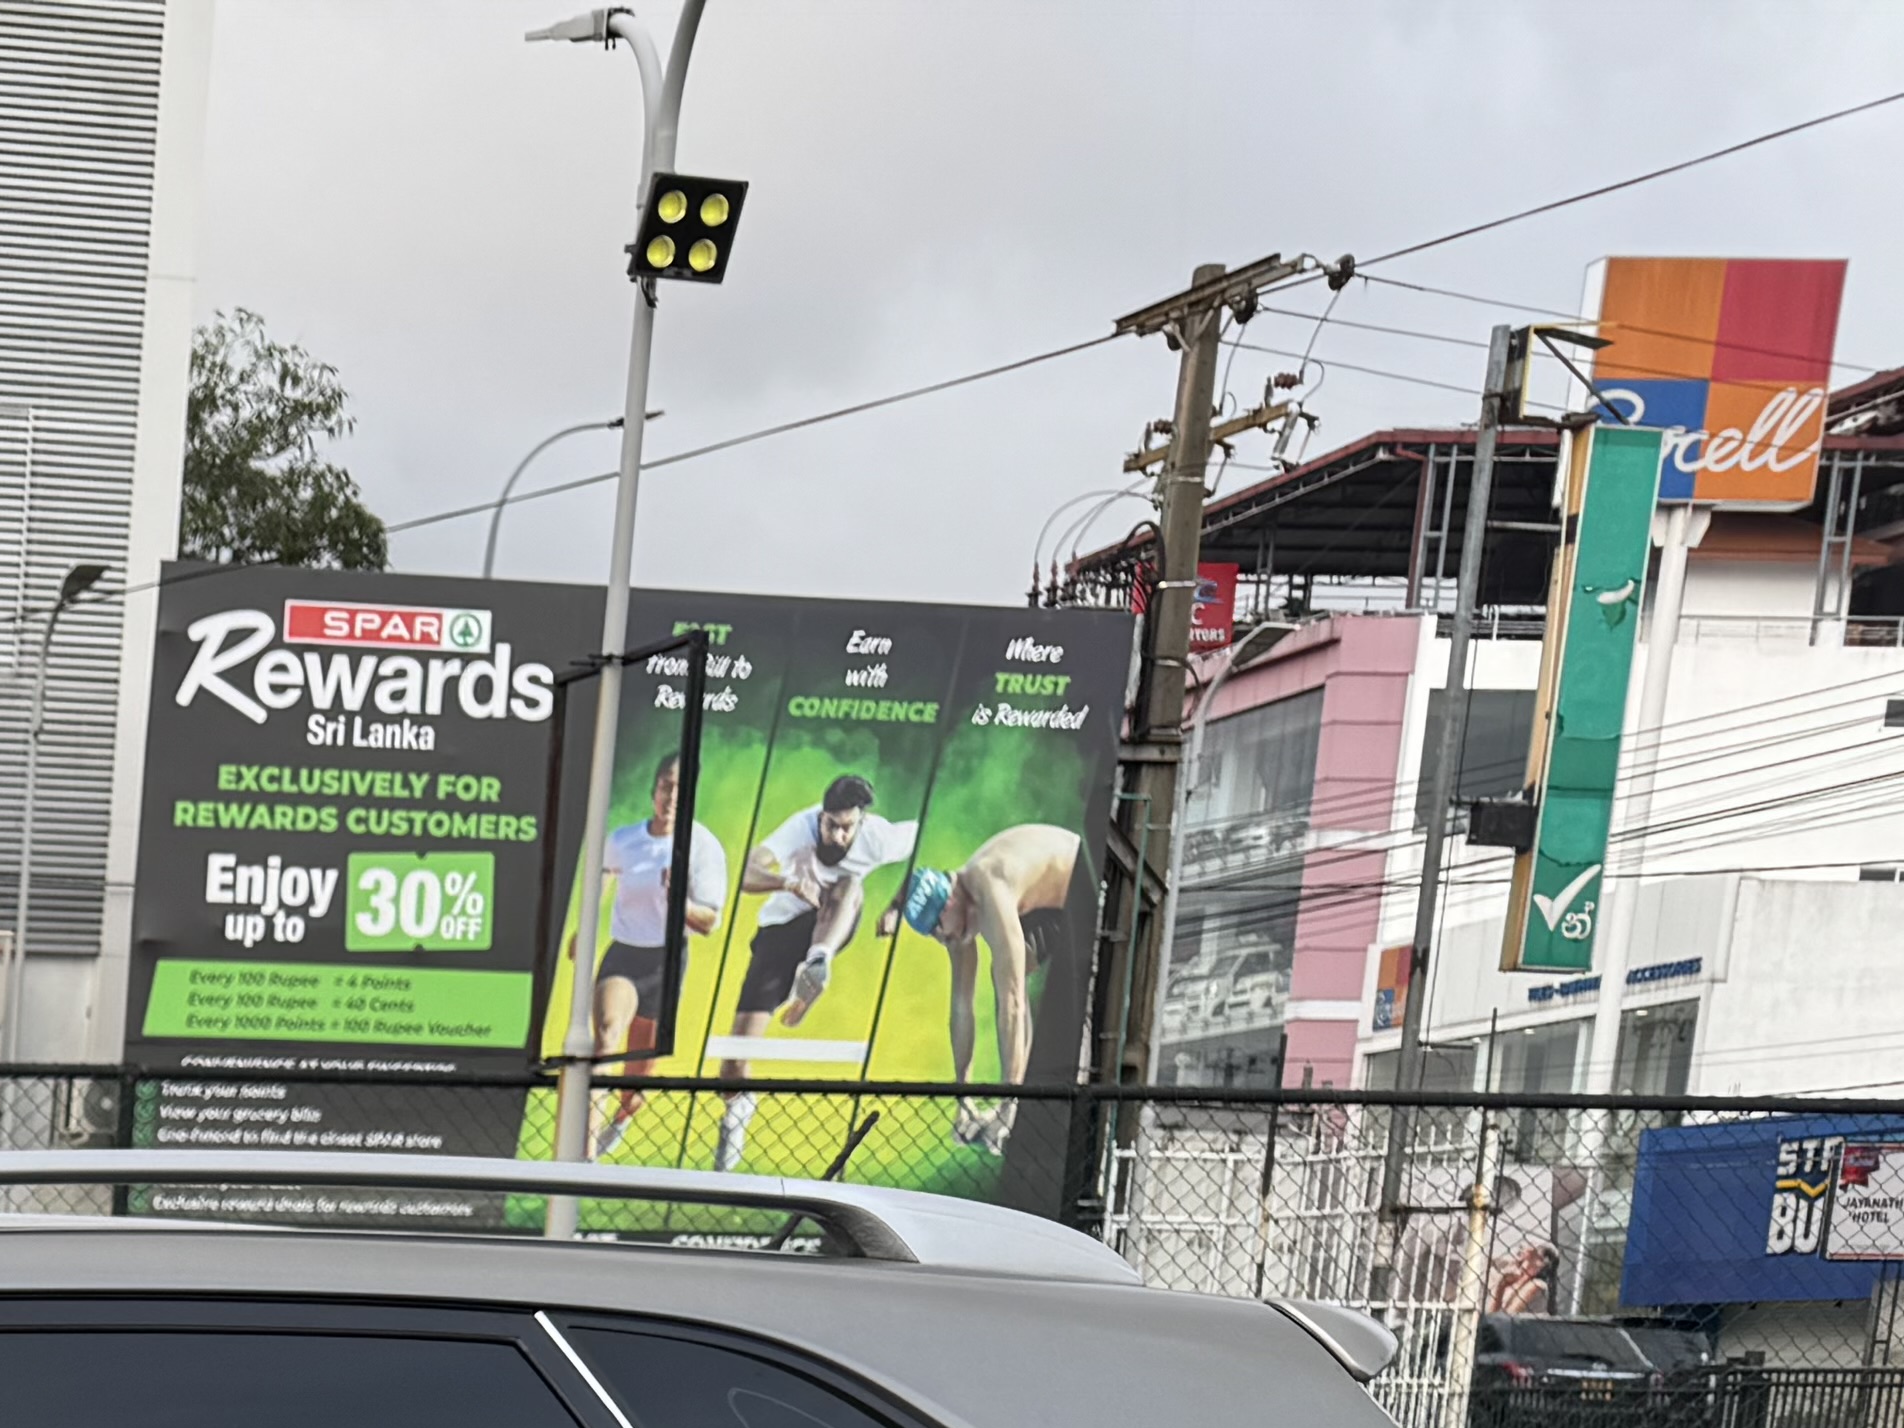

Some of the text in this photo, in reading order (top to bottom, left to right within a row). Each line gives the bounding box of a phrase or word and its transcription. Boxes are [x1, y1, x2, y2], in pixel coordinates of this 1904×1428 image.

[324, 610, 440, 646] SPAR
[846, 629, 893, 656] Earn
[1005, 637, 1064, 664] Where
[175, 609, 554, 724] Rewards
[845, 663, 888, 689] with
[995, 672, 1071, 696] TRUST
[787, 696, 940, 723] CONFIDENCE
[971, 702, 1090, 731] is Rewarded
[307, 713, 435, 751] Sri Lanka
[218, 764, 501, 802] EXCLUSIVELY FOR
[174, 801, 537, 842] REWARDS CUSTOMERS
[206, 852, 485, 938] Enjoy 30%
[225, 910, 305, 948] up to
[441, 916, 481, 941] OFF
[1852, 1210, 1889, 1223] HOTEL
